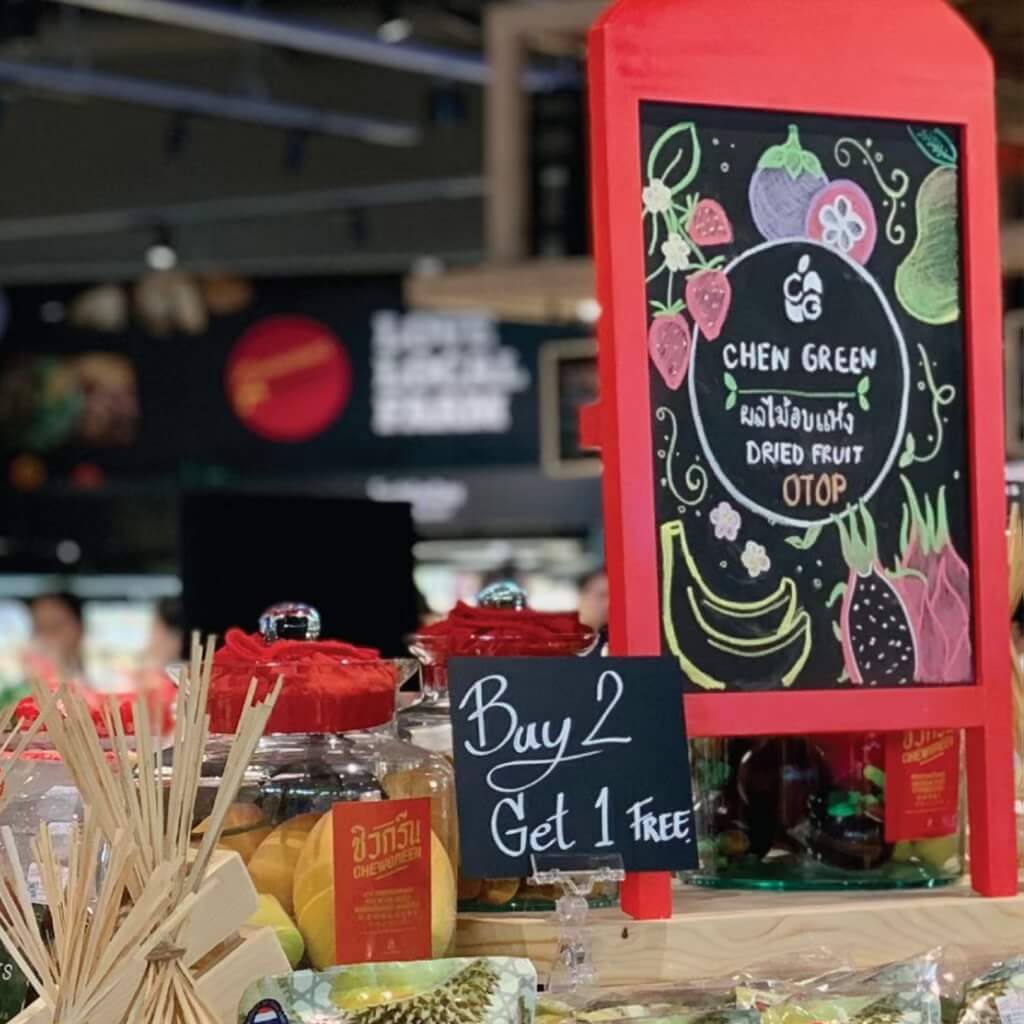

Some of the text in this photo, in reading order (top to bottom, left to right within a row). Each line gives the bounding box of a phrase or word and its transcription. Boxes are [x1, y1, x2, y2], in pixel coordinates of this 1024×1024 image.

[802, 343, 877, 374] GREEN
[740, 396, 855, 435] ผลไม้อบแห้ง
[746, 440, 865, 466] DRIED FRUIT
[782, 473, 847, 507] OTOP
[459, 670, 632, 793] Buy 2
[490, 792, 576, 857] Get
[594, 786, 615, 847] 1
